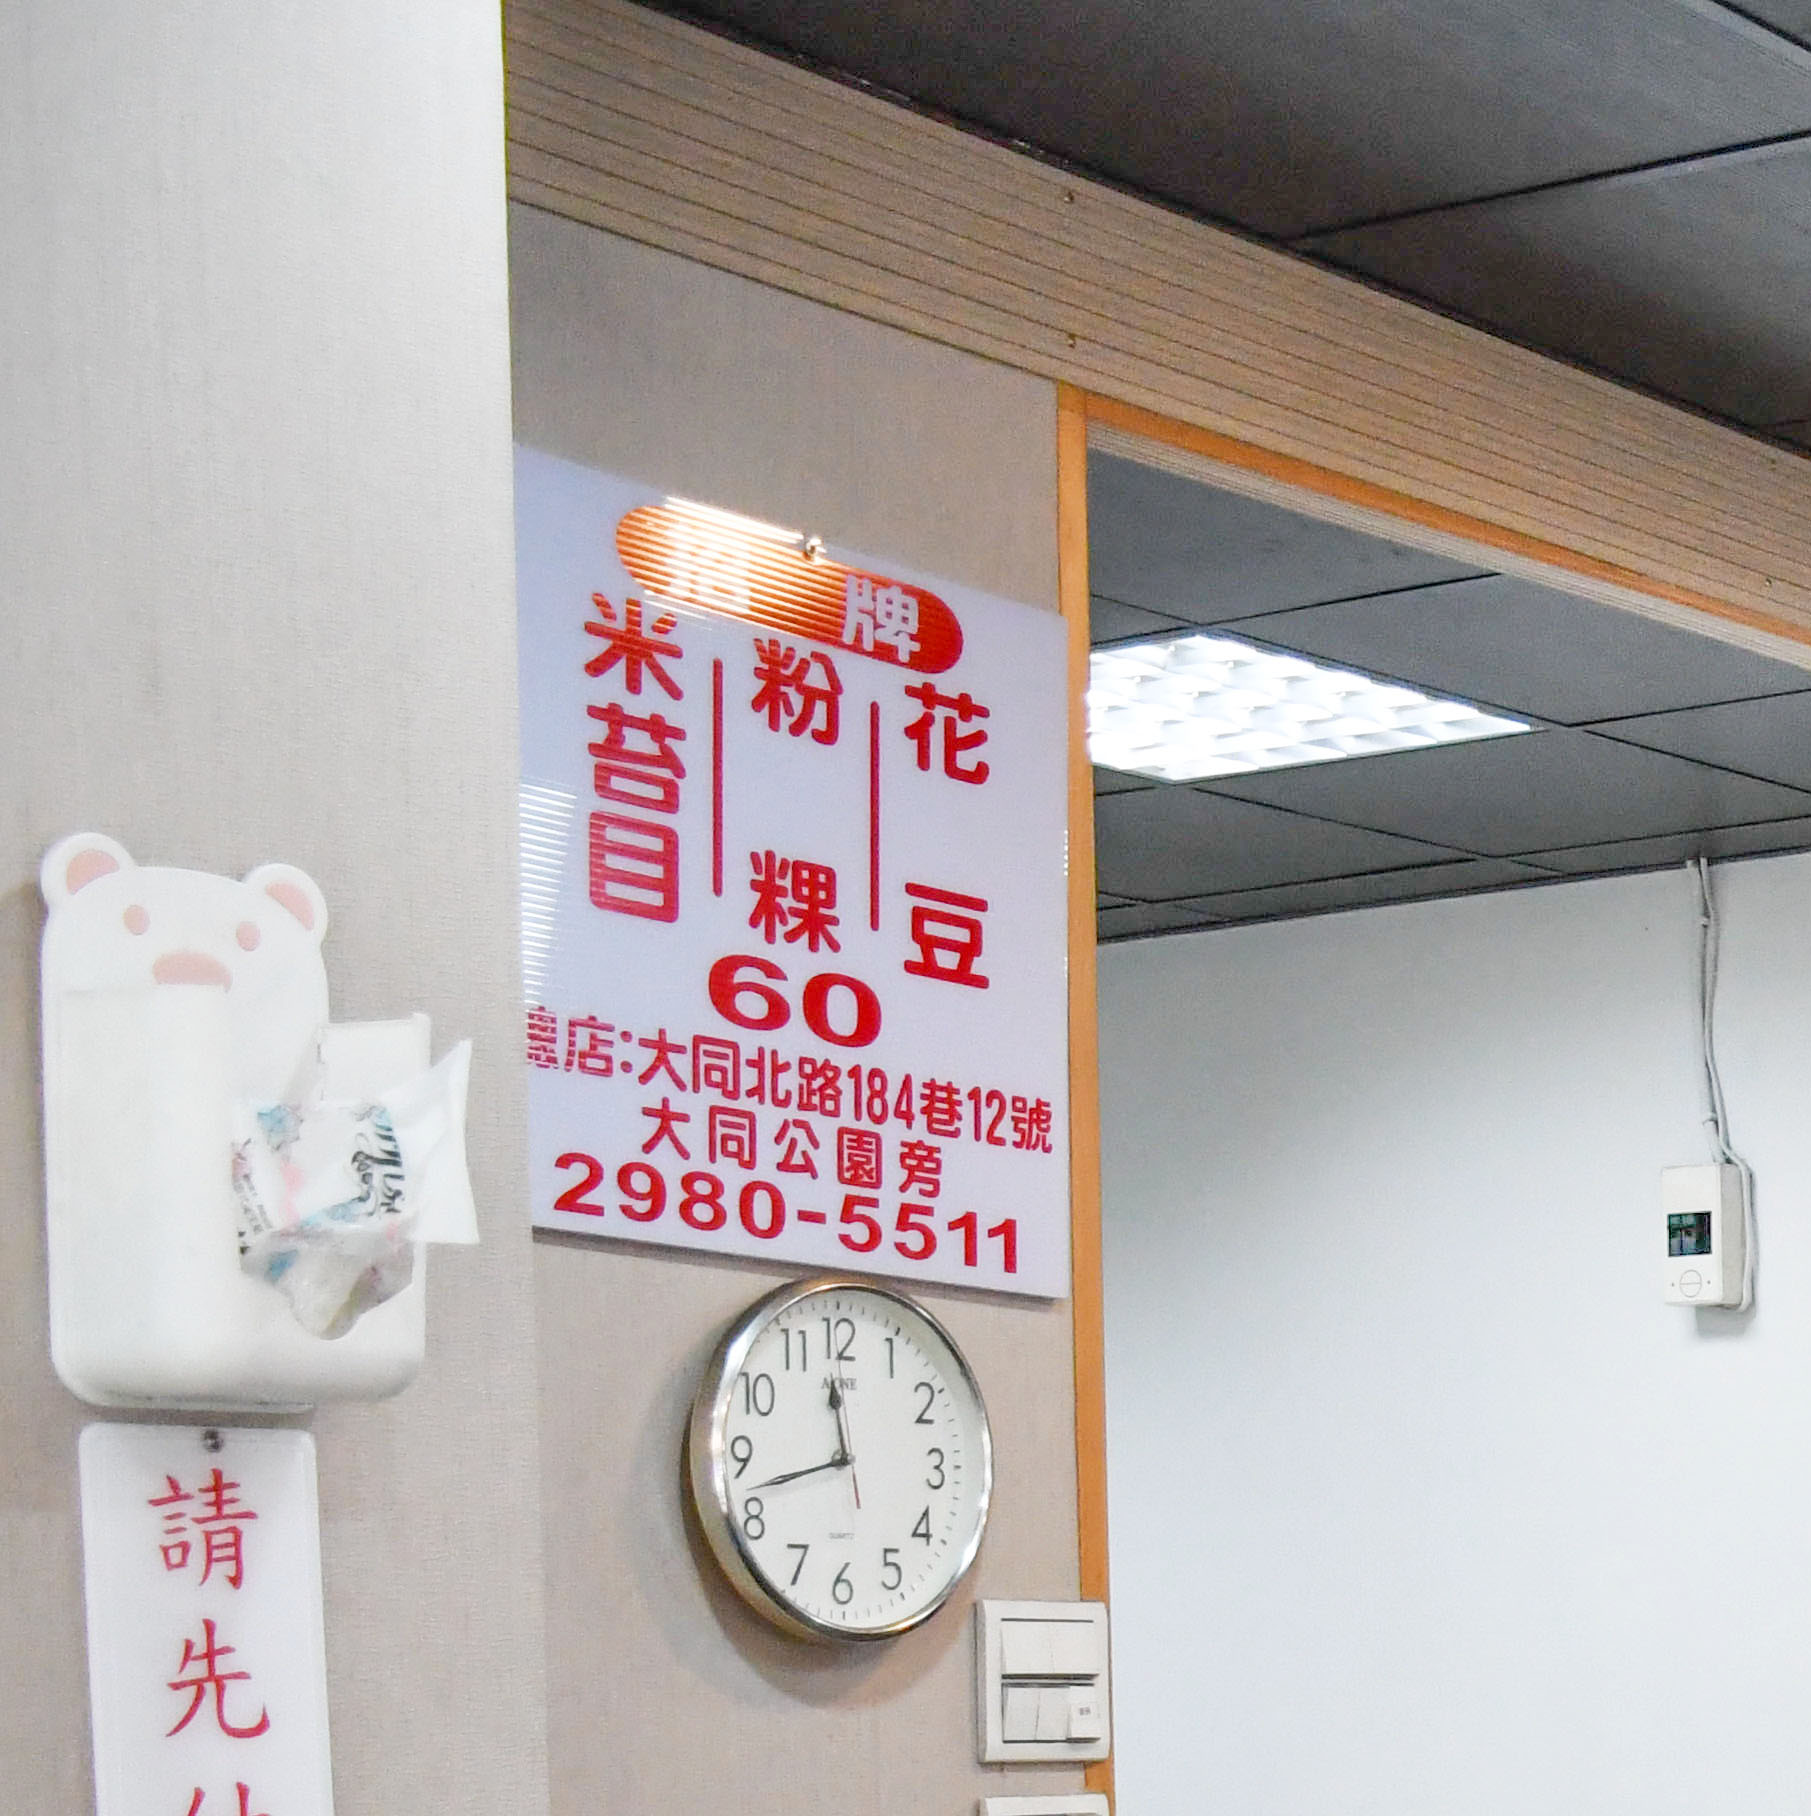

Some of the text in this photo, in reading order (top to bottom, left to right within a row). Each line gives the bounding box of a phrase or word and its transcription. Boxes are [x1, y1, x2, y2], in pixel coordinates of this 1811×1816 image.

[584, 592, 685, 924] 米苔目
[749, 638, 844, 953] 粉粿
[904, 681, 991, 990] 花豆
[708, 953, 883, 1048] 60
[642, 1098, 943, 1200] 大同公園旁
[553, 1152, 1020, 1274] 2980-5511
[779, 1327, 807, 1372] 11
[821, 1316, 856, 1362] 12
[884, 1337, 894, 1379] 1
[737, 1371, 775, 1417] 10
[914, 1381, 935, 1425] 2
[730, 1434, 753, 1479] 9
[926, 1447, 946, 1491] 3
[740, 1496, 766, 1543] 8
[910, 1505, 933, 1546] 4
[786, 1543, 810, 1586] 7
[831, 1562, 854, 1606] 6
[881, 1547, 902, 1591] 5
